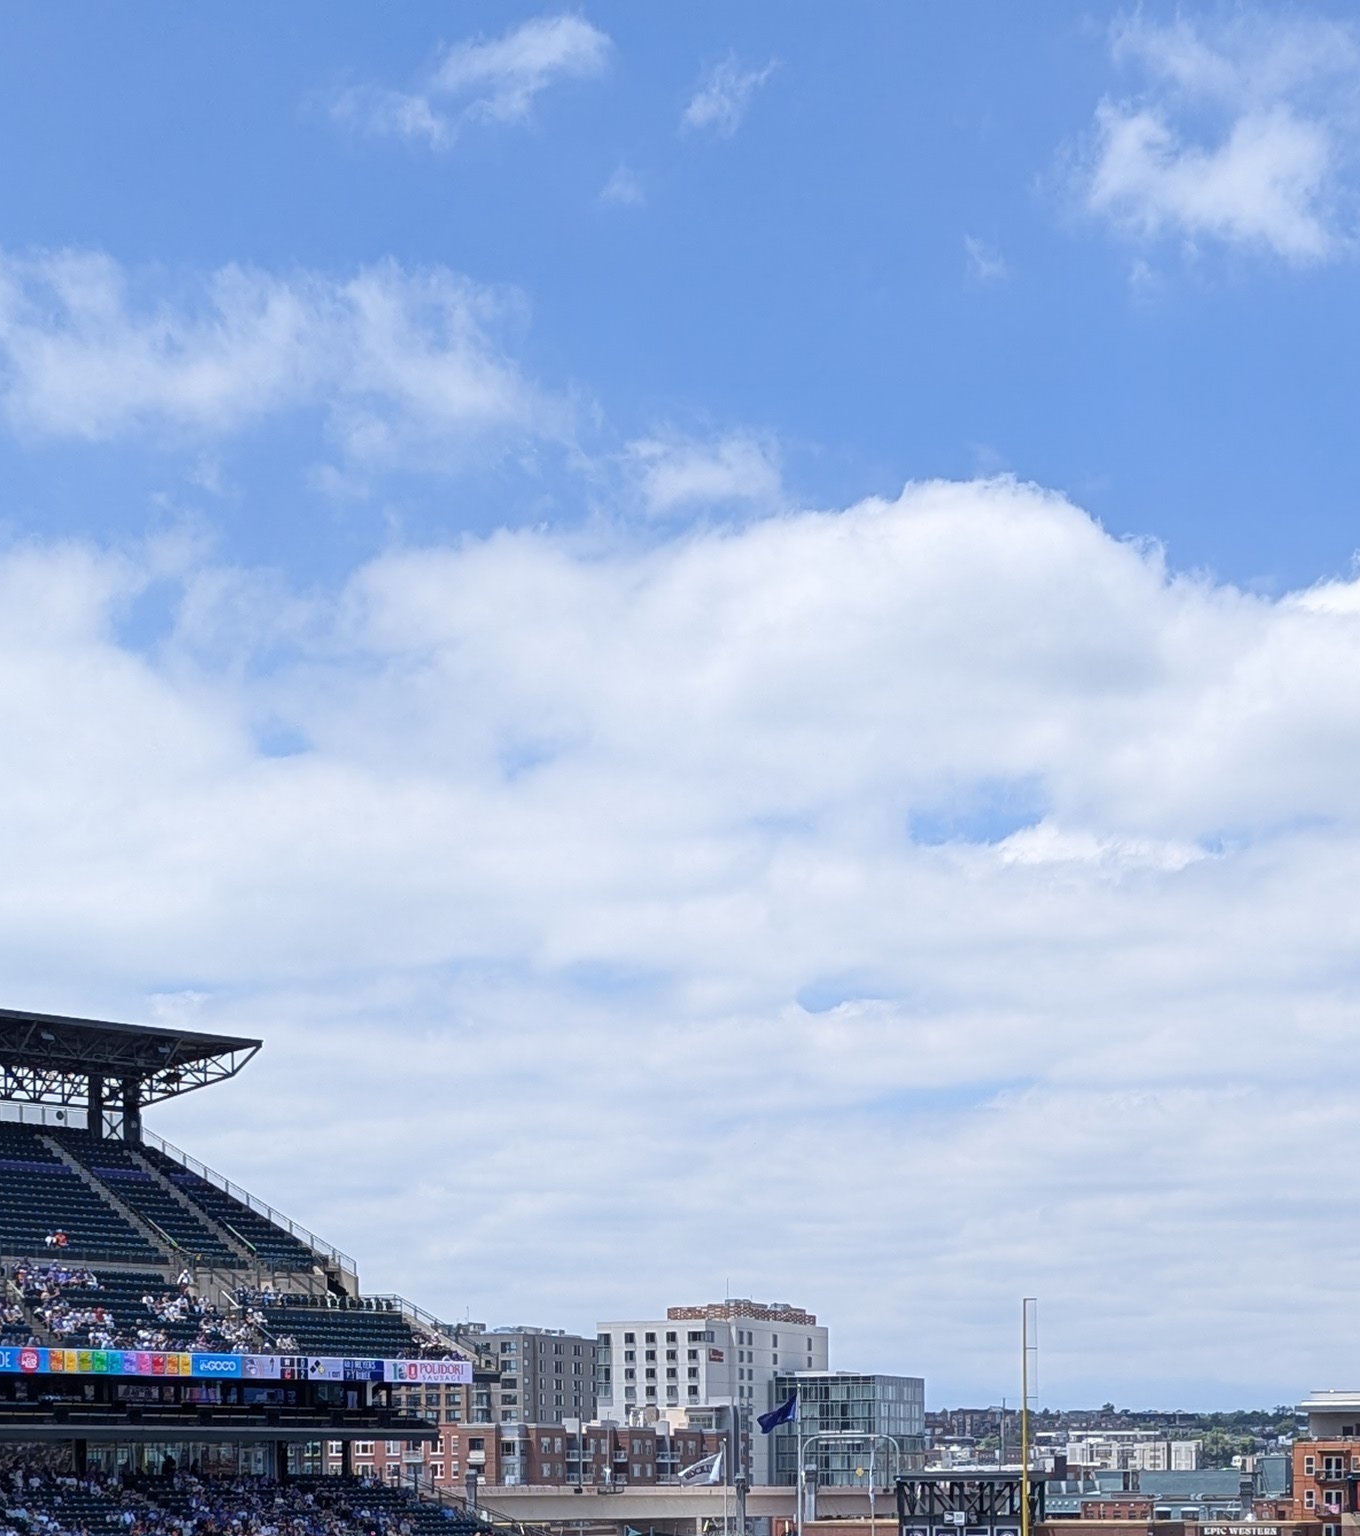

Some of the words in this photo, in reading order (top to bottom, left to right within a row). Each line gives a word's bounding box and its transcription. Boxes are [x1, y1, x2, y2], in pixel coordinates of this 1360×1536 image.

[419, 1363, 464, 1375] POLIDORI
[1203, 1527, 1227, 1535] EPIC
[1229, 1527, 1277, 1535] WESTERN
